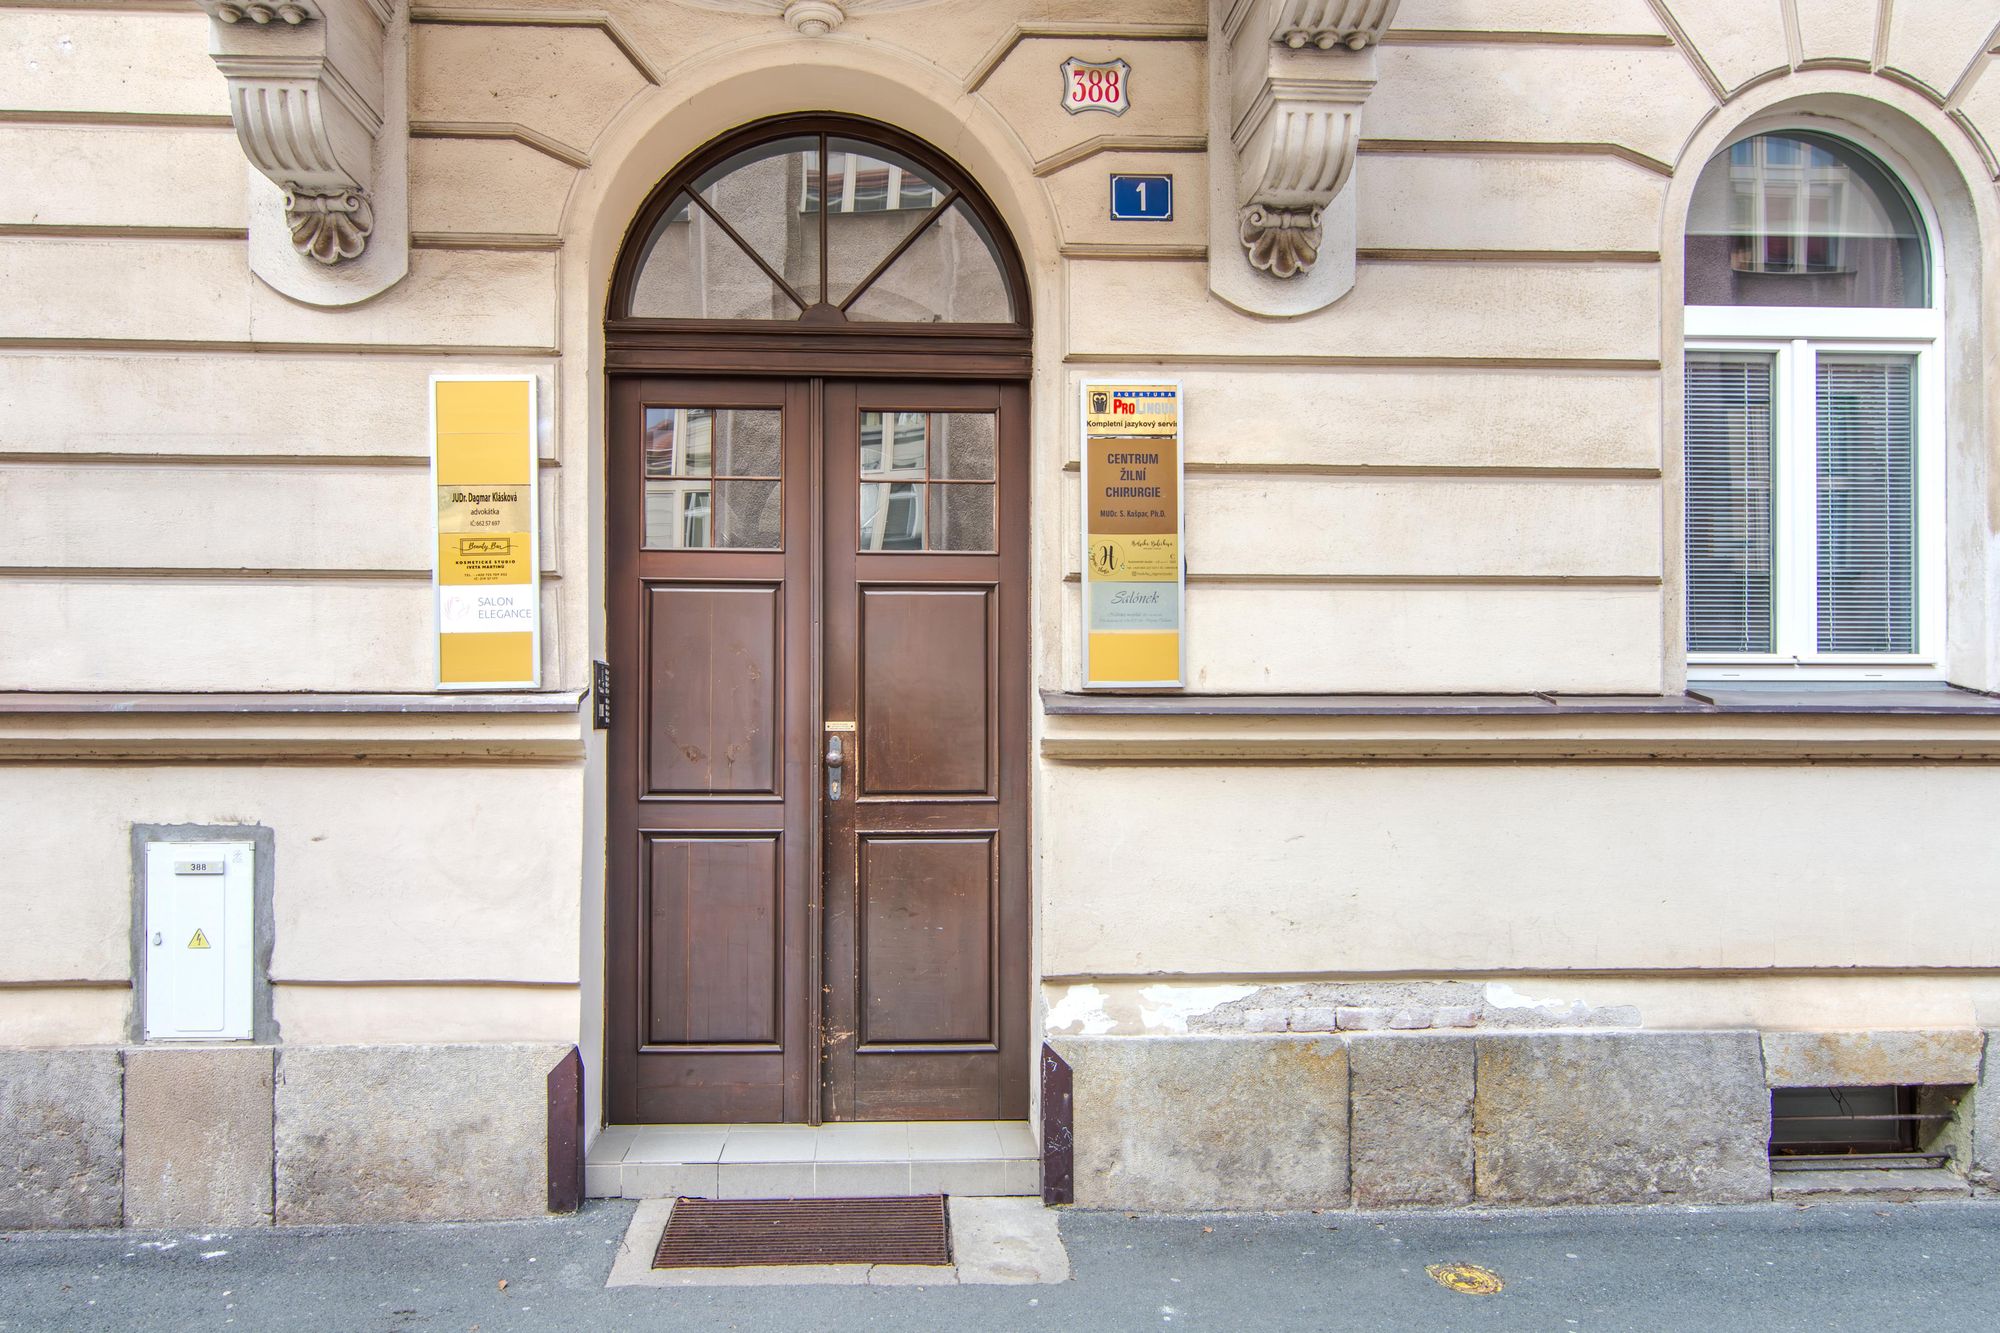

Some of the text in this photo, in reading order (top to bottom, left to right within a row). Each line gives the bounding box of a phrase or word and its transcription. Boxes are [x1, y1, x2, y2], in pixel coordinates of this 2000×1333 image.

[1072, 69, 1120, 103] 388
[1135, 182, 1147, 211] 1
[1087, 420, 1123, 429] Kompletní
[1124, 420, 1156, 429] jazykový
[1107, 453, 1159, 464] CENTRUM
[1120, 467, 1146, 481] ŽILNÍ
[1105, 487, 1161, 497] CHIRURGIE
[452, 491, 518, 505] JUDr. Dagmar Klásková
[470, 508, 500, 516] advokátka
[478, 597, 514, 606] SALON
[1111, 590, 1160, 605] Salónek
[478, 609, 532, 619] ELEGANCE
